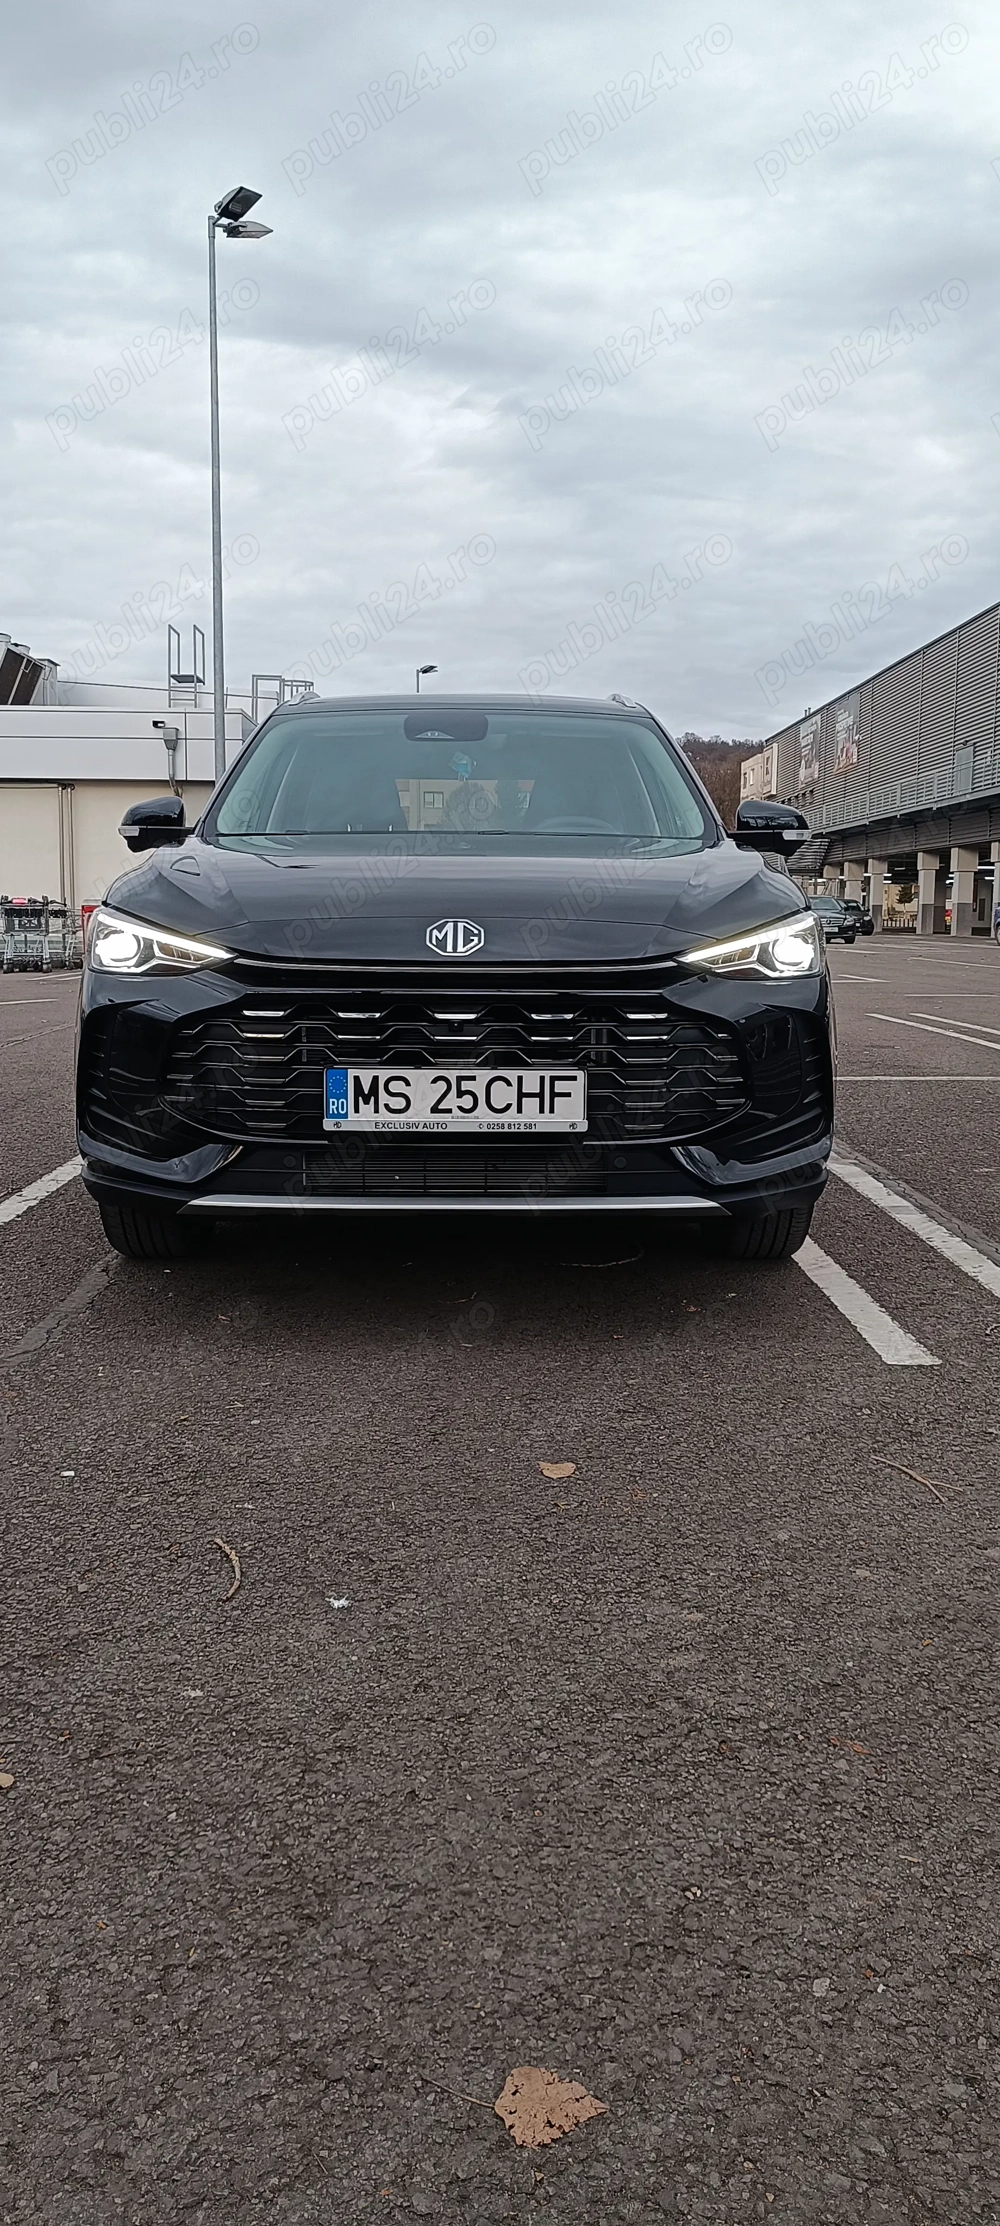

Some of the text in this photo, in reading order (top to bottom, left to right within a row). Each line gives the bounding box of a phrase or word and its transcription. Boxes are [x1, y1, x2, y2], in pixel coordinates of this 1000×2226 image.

[430, 920, 481, 954] MG
[353, 1074, 412, 1114] MS
[329, 1098, 347, 1114] RO
[374, 1121, 448, 1130] EXCLUSIV AUTO
[486, 1122, 537, 1130] 0258 812 581
